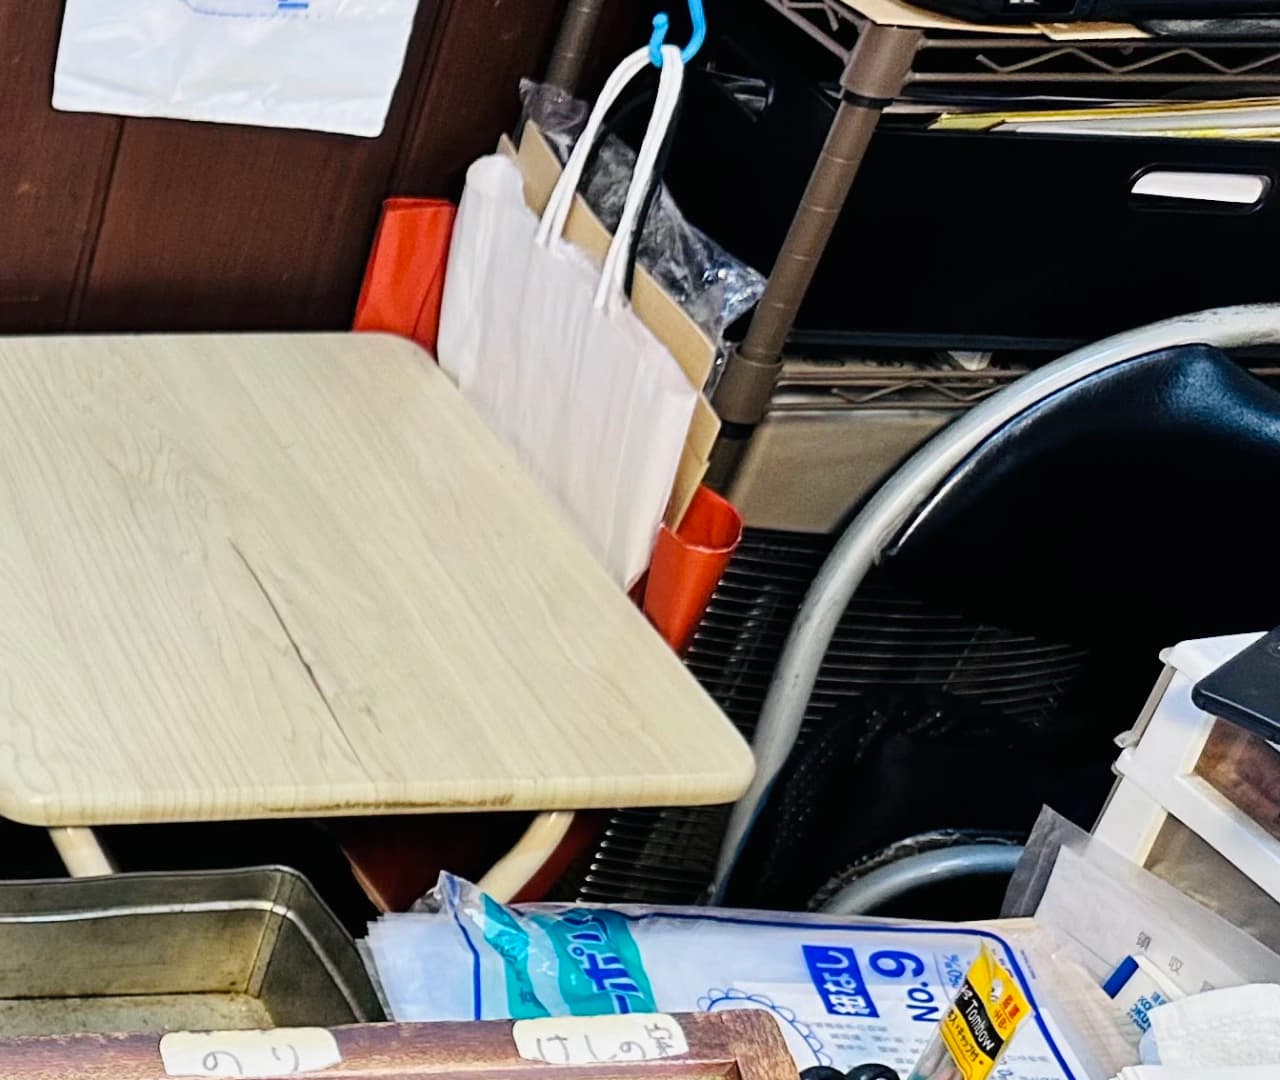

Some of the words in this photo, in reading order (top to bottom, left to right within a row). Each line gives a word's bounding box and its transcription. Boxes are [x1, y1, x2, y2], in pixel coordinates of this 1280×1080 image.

[816, 949, 871, 1016] 紐なし
[536, 1023, 675, 1064] けしの実
[964, 999, 995, 1052] Tombow
[201, 1043, 300, 1076] のり
